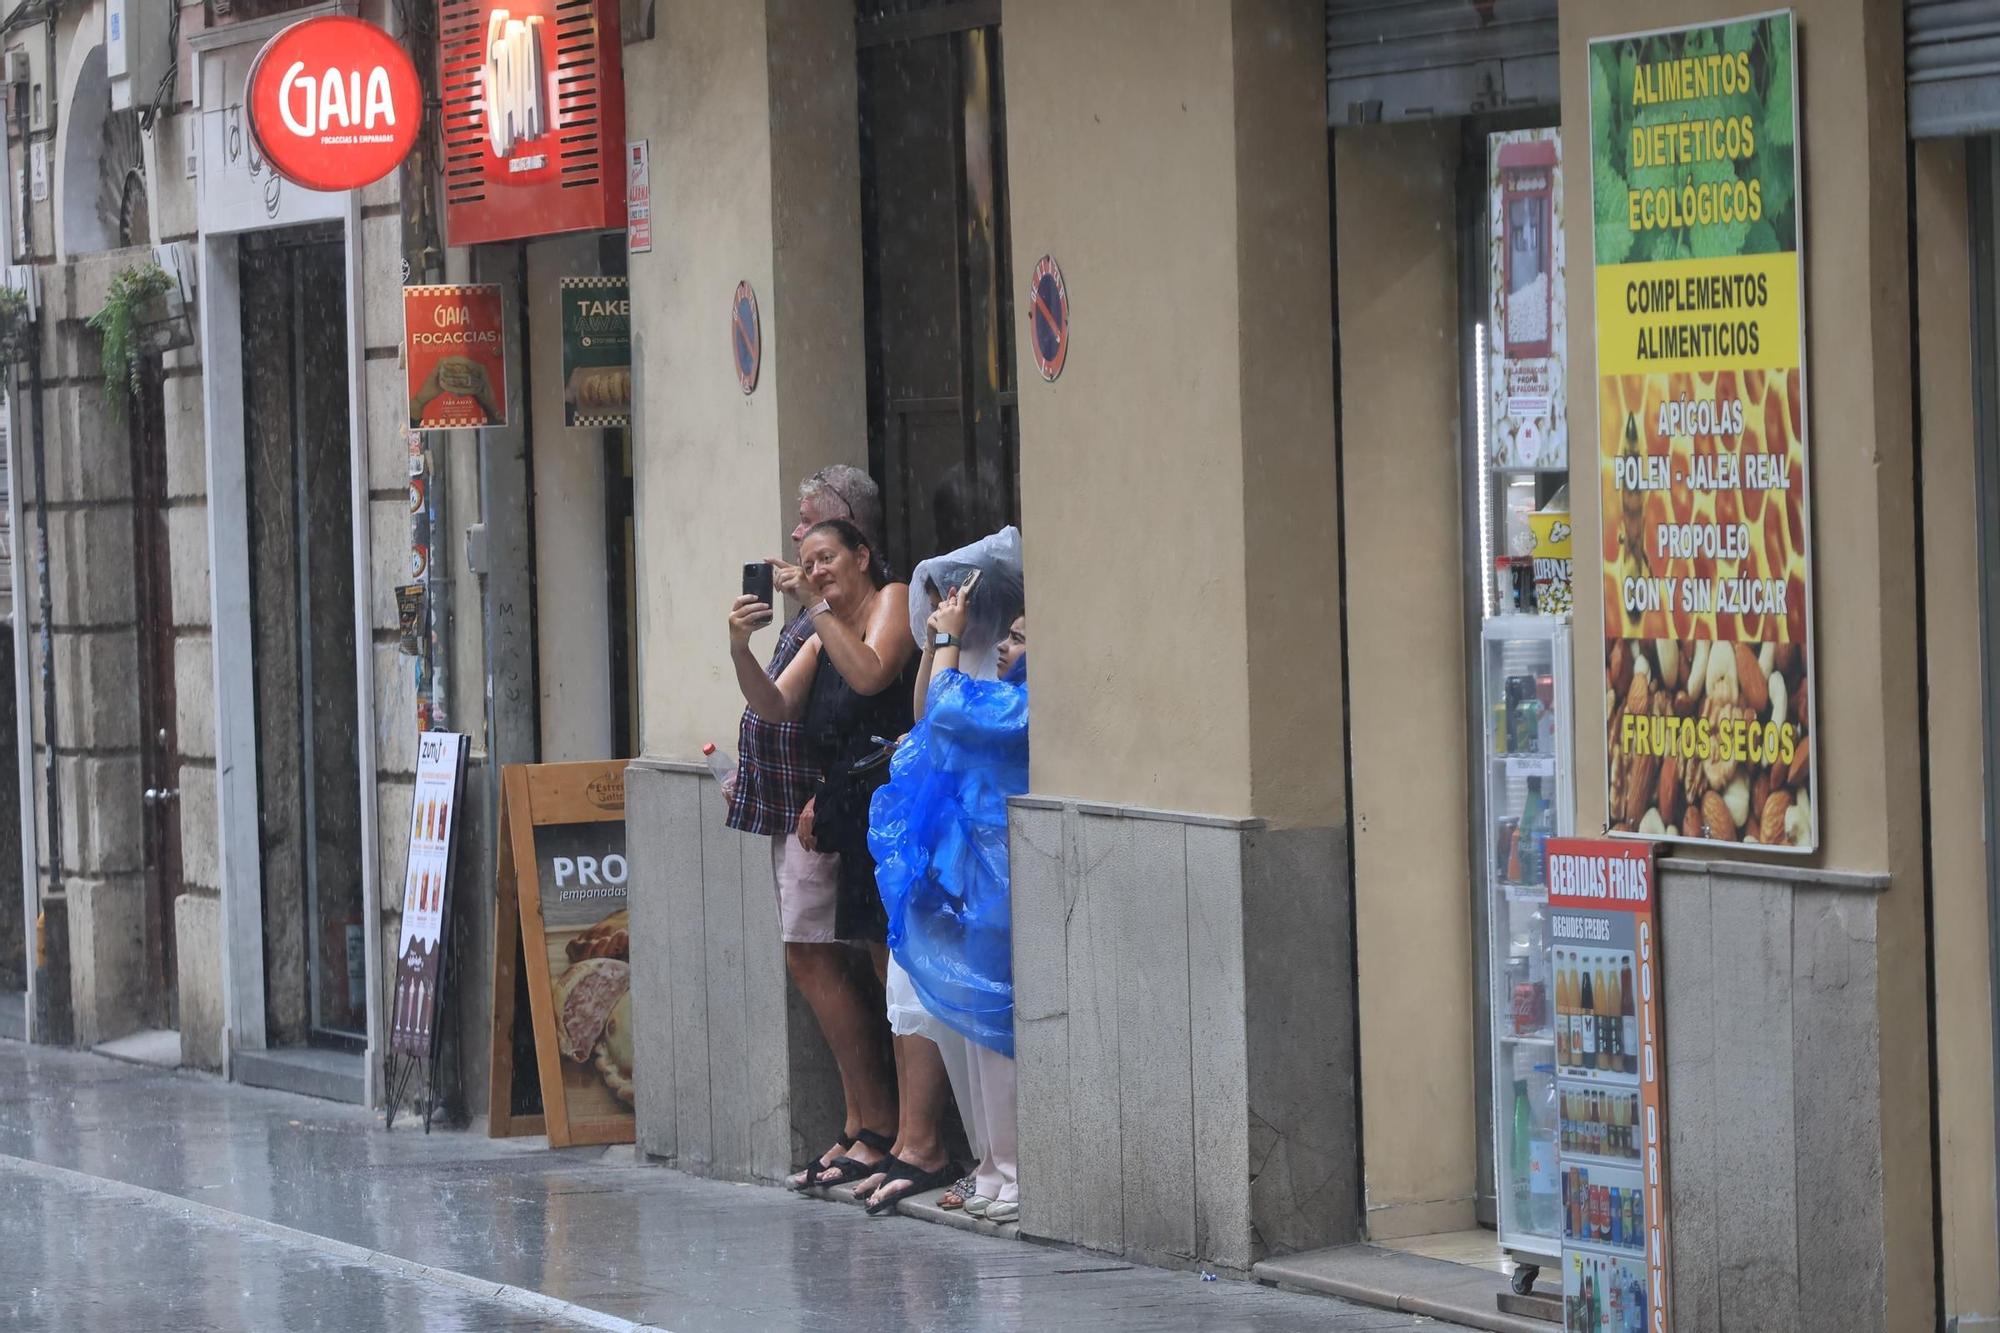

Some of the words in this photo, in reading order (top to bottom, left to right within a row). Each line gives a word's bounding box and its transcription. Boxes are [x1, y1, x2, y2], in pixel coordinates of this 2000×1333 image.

[279, 61, 396, 136] GAIA
[1632, 51, 1750, 105] ALIMENTOS
[321, 136, 352, 144] FOCACCIAS
[1632, 112, 1754, 168] DIETÉTICOS
[1628, 176, 1761, 231] ECOLÓGICOS
[577, 300, 629, 316] TAKE
[1627, 272, 1767, 314] COMPLEMENTOS
[434, 304, 470, 327] GAIA
[412, 331, 496, 345] FOCACCIAS
[1637, 321, 1760, 360] ALIMENTICIOS
[1658, 393, 1743, 436] APÍCOLAS
[1615, 455, 1671, 490] POLEN
[1686, 454, 1741, 490] JALEA
[1745, 454, 1790, 490] REAL
[1658, 522, 1750, 559] PROPOLEO
[1623, 576, 1662, 612] CON
[1665, 576, 1679, 611] Y
[1682, 576, 1711, 613] SIN
[1716, 571, 1788, 615] AZÚCAR
[1622, 714, 1711, 760] FRUTOS
[1720, 717, 1795, 765] SECOS
[553, 854, 627, 887] PRO
[1549, 854, 1607, 898] BEBIDAS
[1608, 850, 1647, 901] FRÍAS
[1553, 915, 1583, 939] BEGUDES
[1584, 917, 1610, 941] FREDES
[1640, 921, 1654, 1082] COLD
